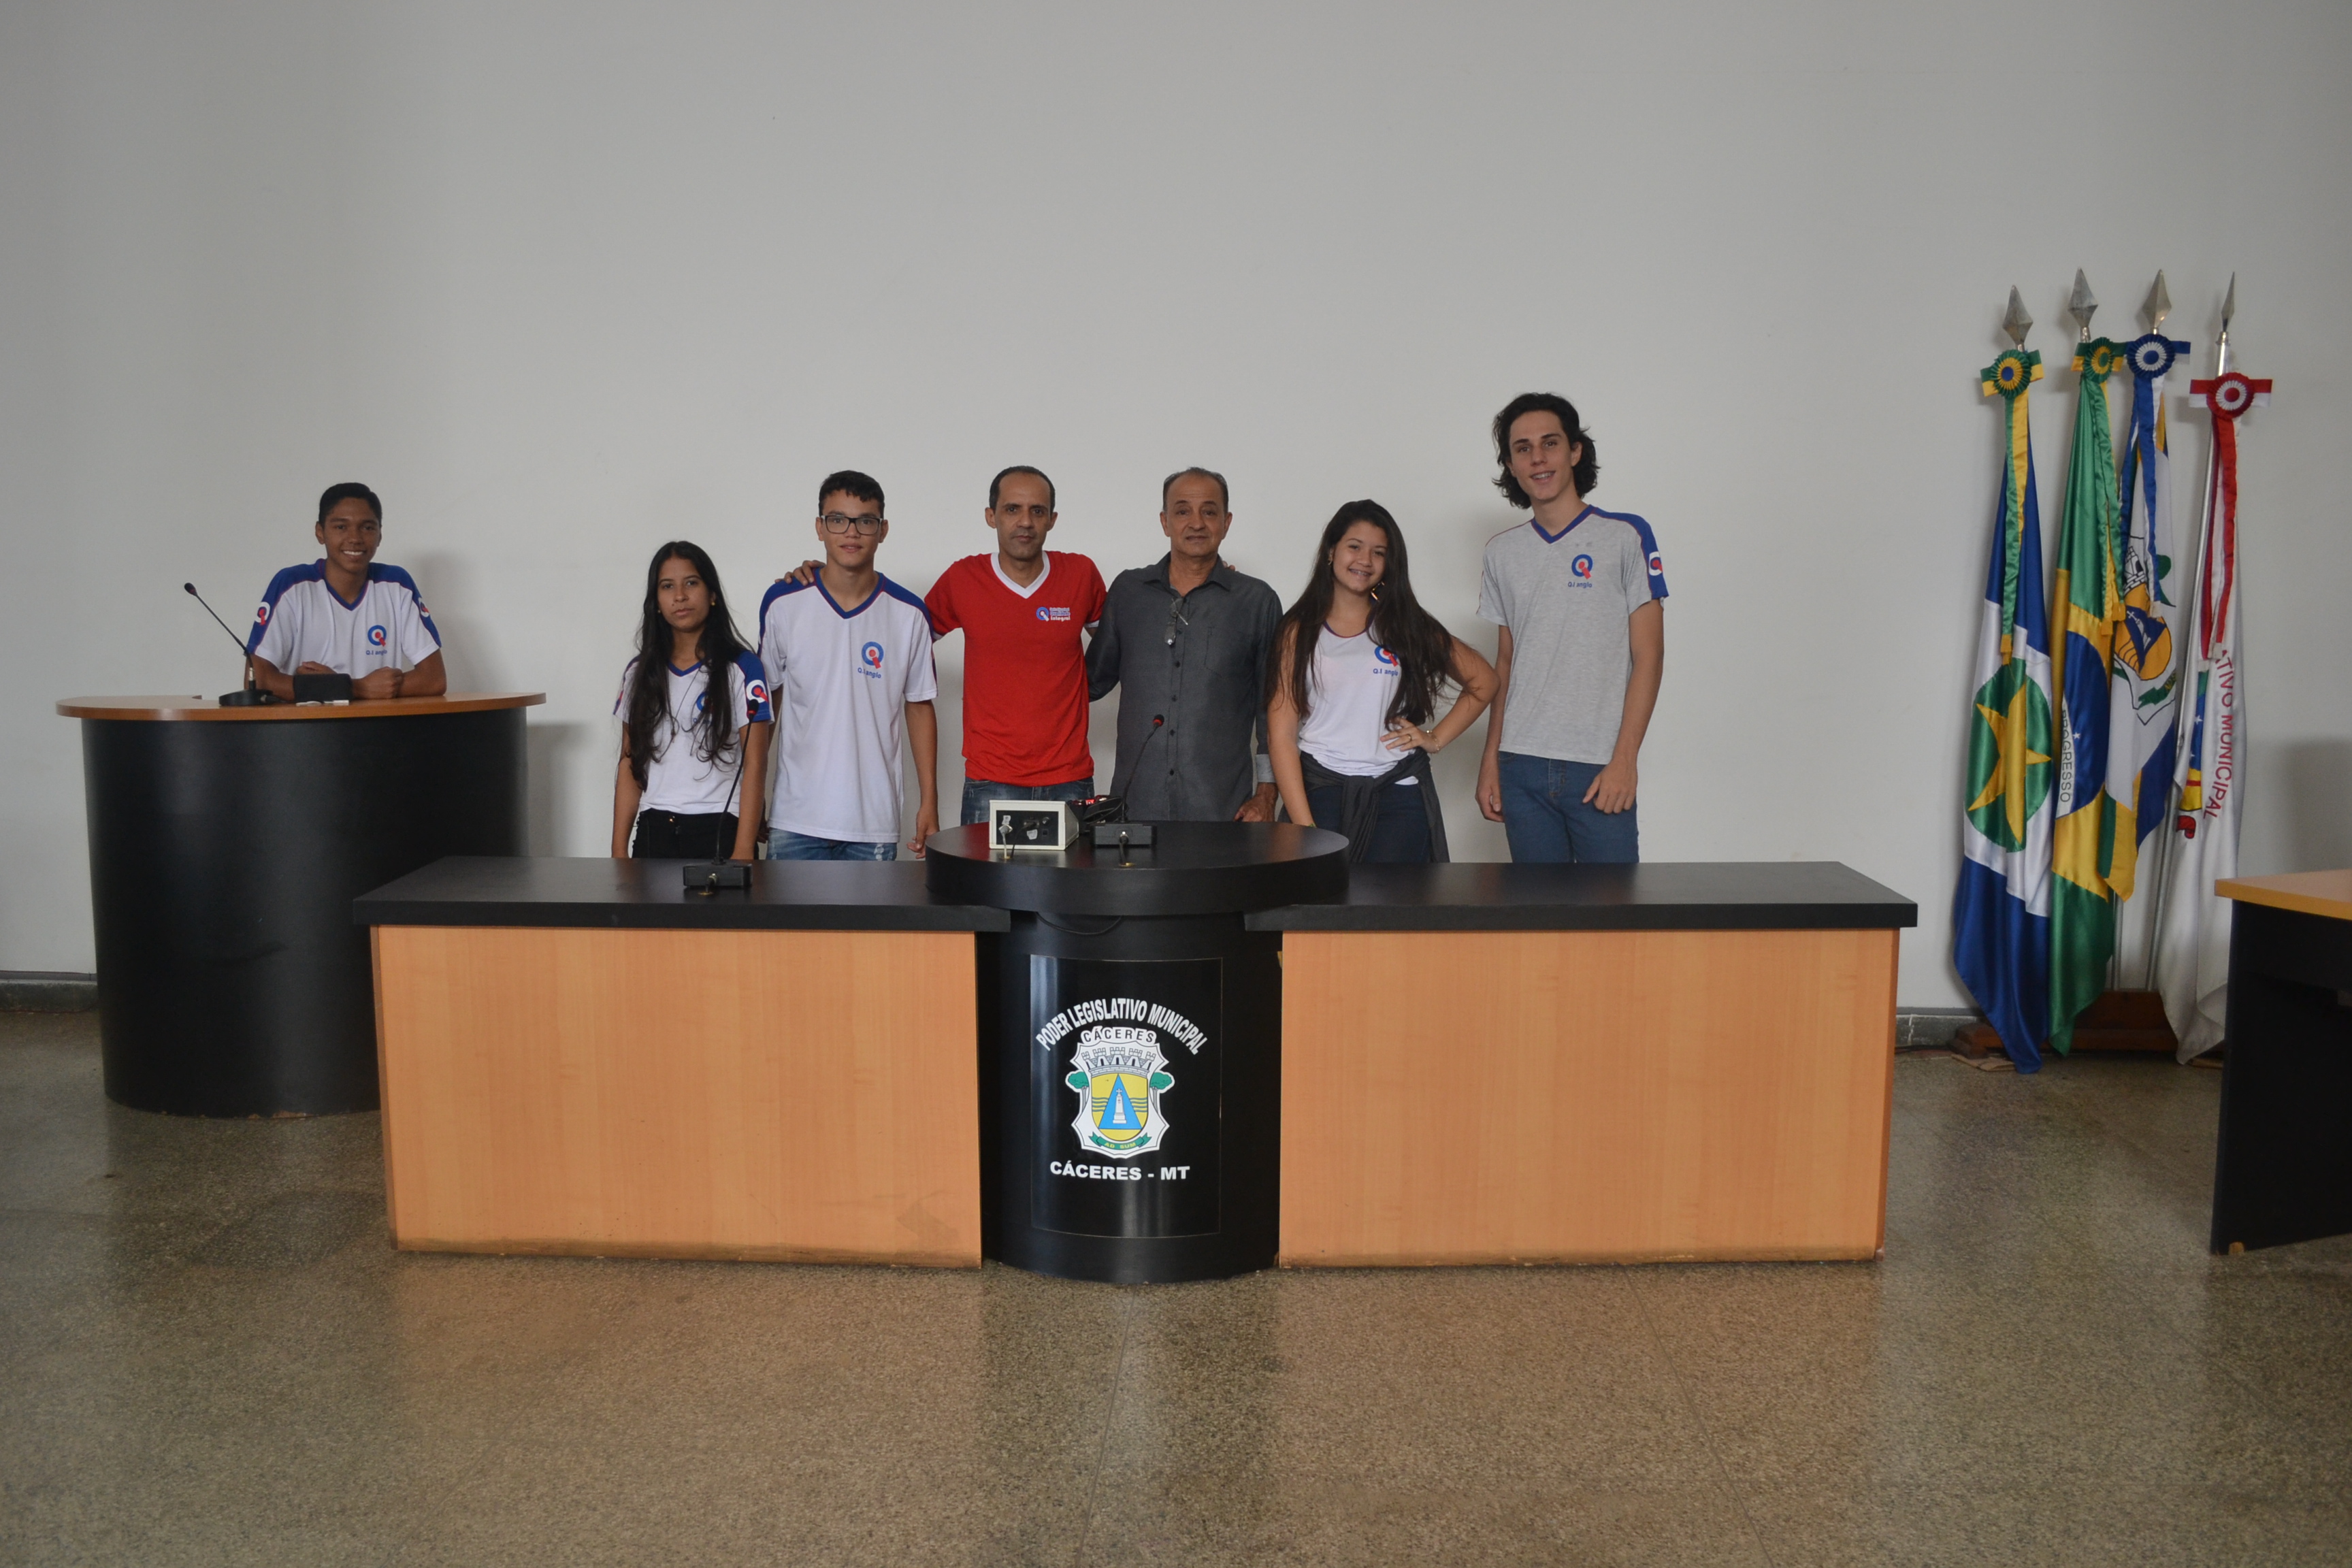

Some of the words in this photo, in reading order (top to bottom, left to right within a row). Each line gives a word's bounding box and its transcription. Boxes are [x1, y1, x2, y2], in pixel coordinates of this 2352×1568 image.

[2203, 715, 2233, 819] MUNICIPAL
[1035, 1013, 1074, 1051] PODER
[1066, 998, 1147, 1028] LEGISLATIVO
[1147, 1003, 1208, 1056] MUNICIPAL
[1083, 1028, 1154, 1043] CÁCERES
[1050, 1160, 1142, 1180] CÁCERES
[1160, 1166, 1190, 1180] MT
